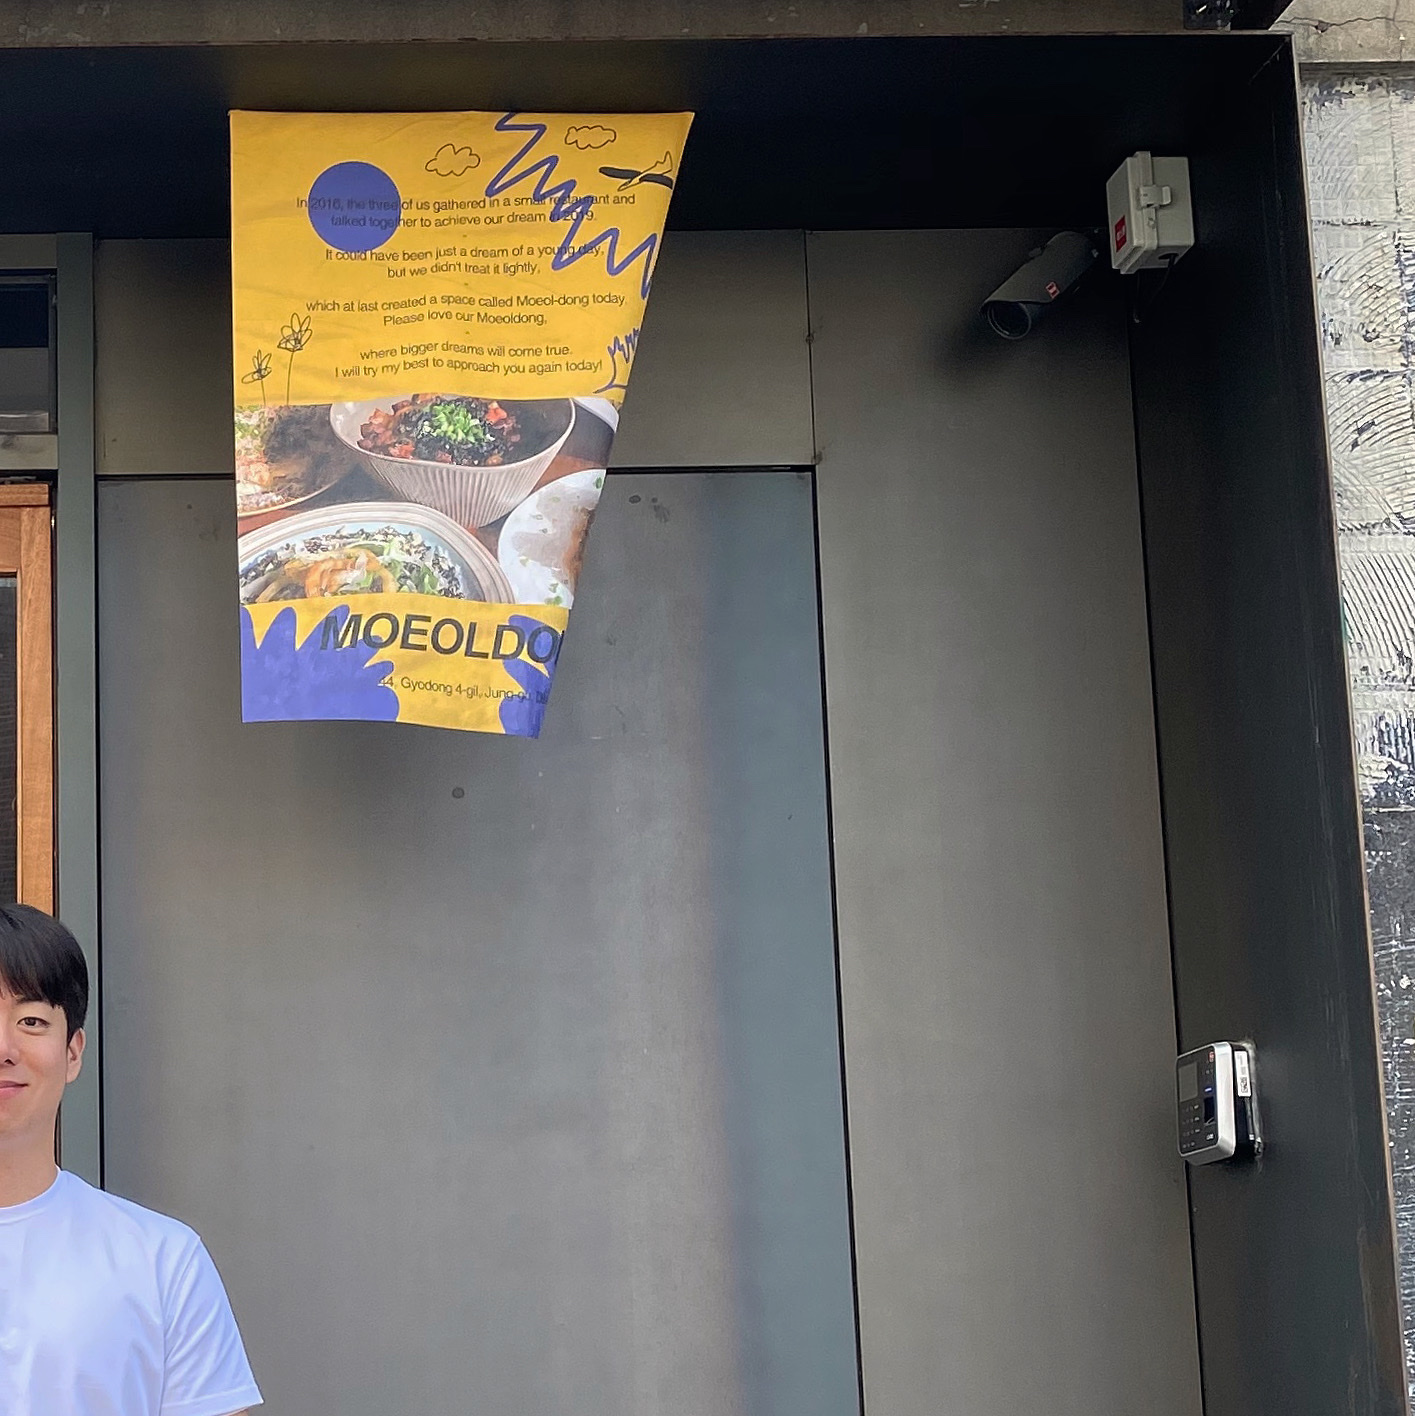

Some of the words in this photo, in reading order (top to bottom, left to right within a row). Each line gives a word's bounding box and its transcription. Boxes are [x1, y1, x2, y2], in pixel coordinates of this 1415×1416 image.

[297, 197, 307, 208] In
[402, 199, 412, 210] of
[416, 200, 430, 210] us
[433, 198, 486, 213] gathered
[489, 197, 500, 207] in
[503, 197, 511, 206] a
[612, 194, 635, 205] and
[331, 215, 366, 227] talked
[369, 215, 417, 230] together
[421, 217, 431, 227] to
[434, 214, 481, 227] achieve
[484, 213, 503, 225] our
[507, 211, 546, 223] dream
[563, 209, 597, 221] 209.
[326, 249, 332, 260] It
[336, 249, 367, 261] could
[370, 250, 399, 261] have
[402, 249, 432, 261] been
[435, 247, 457, 260] just
[460, 248, 467, 257] a
[470, 246, 508, 258] dream
[512, 245, 523, 256] of
[527, 247, 534, 255] a
[537, 246, 575, 259] young
[388, 267, 406, 278] but
[409, 266, 427, 276] we
[430, 261, 461, 274] didn't
[464, 262, 490, 274] treat
[494, 262, 500, 275] it
[306, 299, 340, 311] which
[343, 300, 355, 312] at
[358, 299, 378, 312] last
[381, 294, 427, 311] created
[429, 295, 438, 304] a
[441, 295, 475, 306] space
[478, 296, 513, 308] called
[384, 311, 424, 327] Please
[427, 309, 453, 321] love
[455, 311, 474, 322] our
[360, 348, 398, 361] where
[400, 341, 439, 356] bigger
[441, 340, 484, 356] dreams
[487, 345, 505, 357] will
[508, 346, 543, 357] come
[342, 365, 360, 377] will
[363, 366, 378, 378] try
[382, 362, 400, 375] my
[403, 357, 429, 371] best
[433, 356, 444, 368] to
[446, 358, 500, 374] approach
[503, 363, 525, 377] you
[528, 362, 563, 376] again
[565, 359, 602, 374] today!
[319, 611, 565, 665] MOEOLDO
[401, 677, 453, 697] Gyodong
